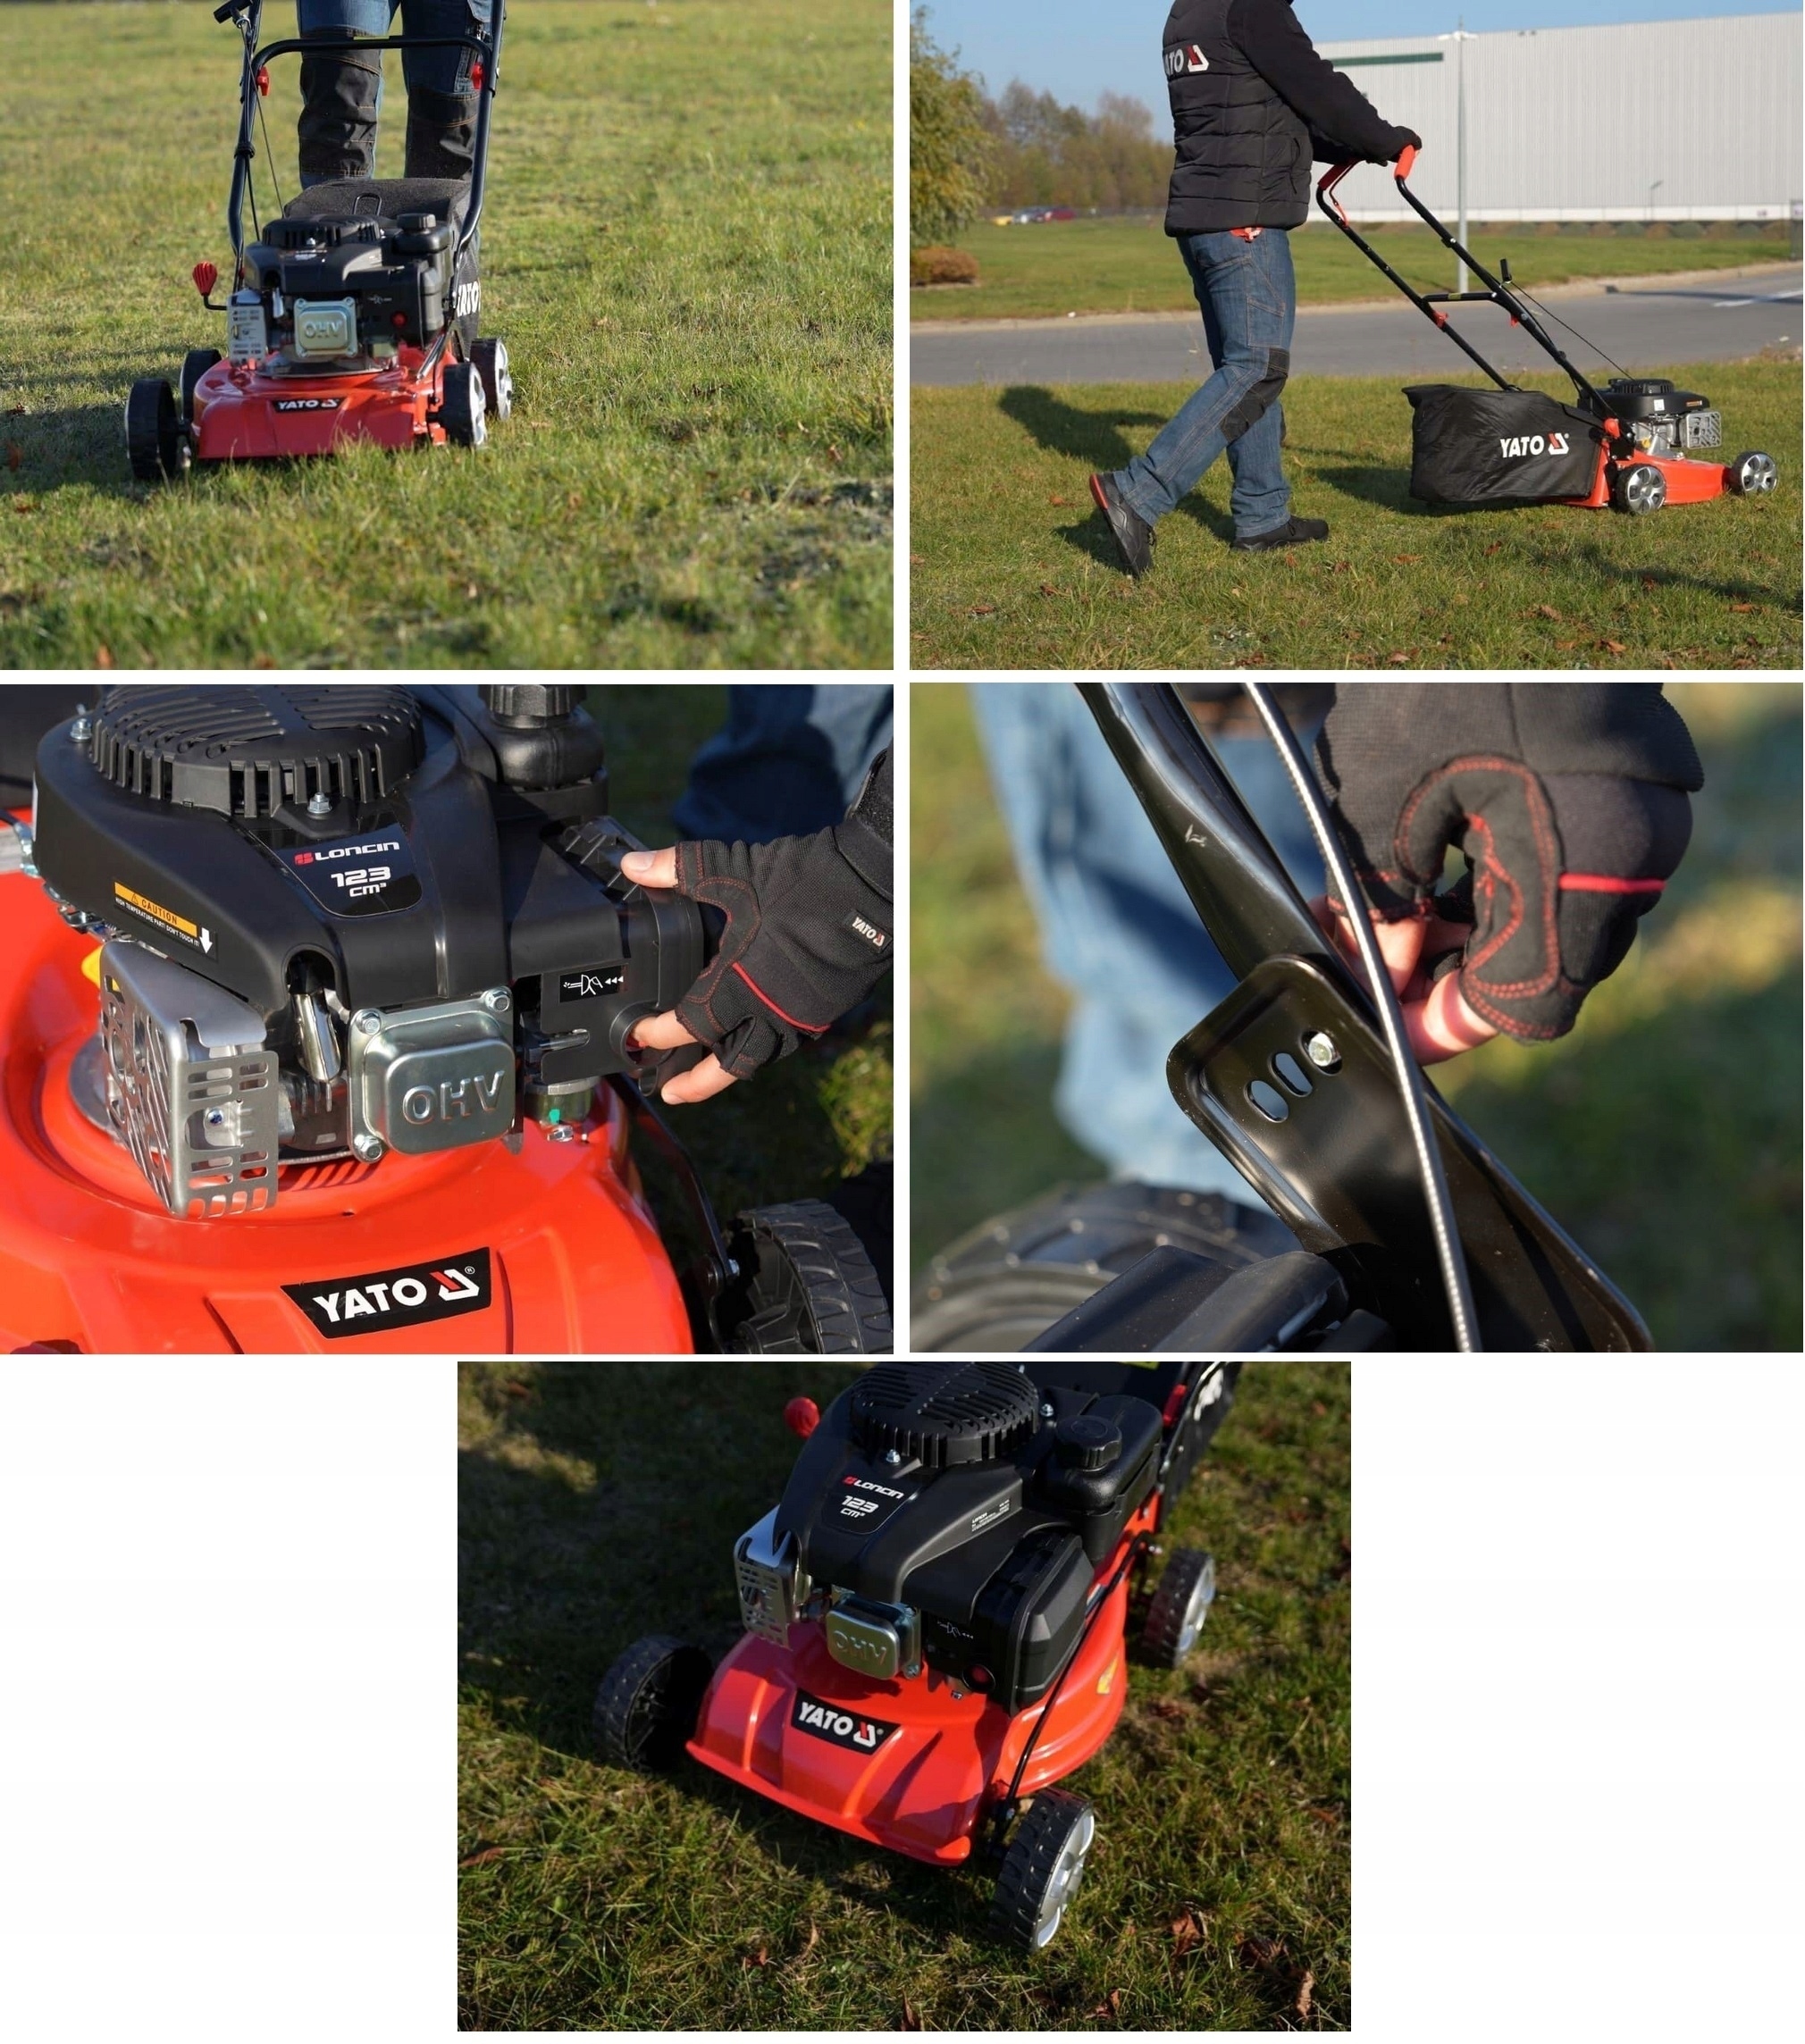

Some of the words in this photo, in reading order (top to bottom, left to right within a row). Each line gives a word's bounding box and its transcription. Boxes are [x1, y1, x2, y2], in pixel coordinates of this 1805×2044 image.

[304, 320, 343, 339] OHV
[279, 399, 319, 410] YATO
[1499, 435, 1544, 458] YATO
[315, 842, 399, 861] LONCIN
[331, 866, 391, 888] 123
[126, 903, 153, 923] TEMPERATURE
[141, 899, 178, 925] CAUTION
[852, 917, 877, 939] YATO
[402, 1070, 505, 1125] OHV
[313, 1278, 427, 1322] YATO
[842, 1495, 879, 1513] 123
[798, 1701, 853, 1736] YATO
